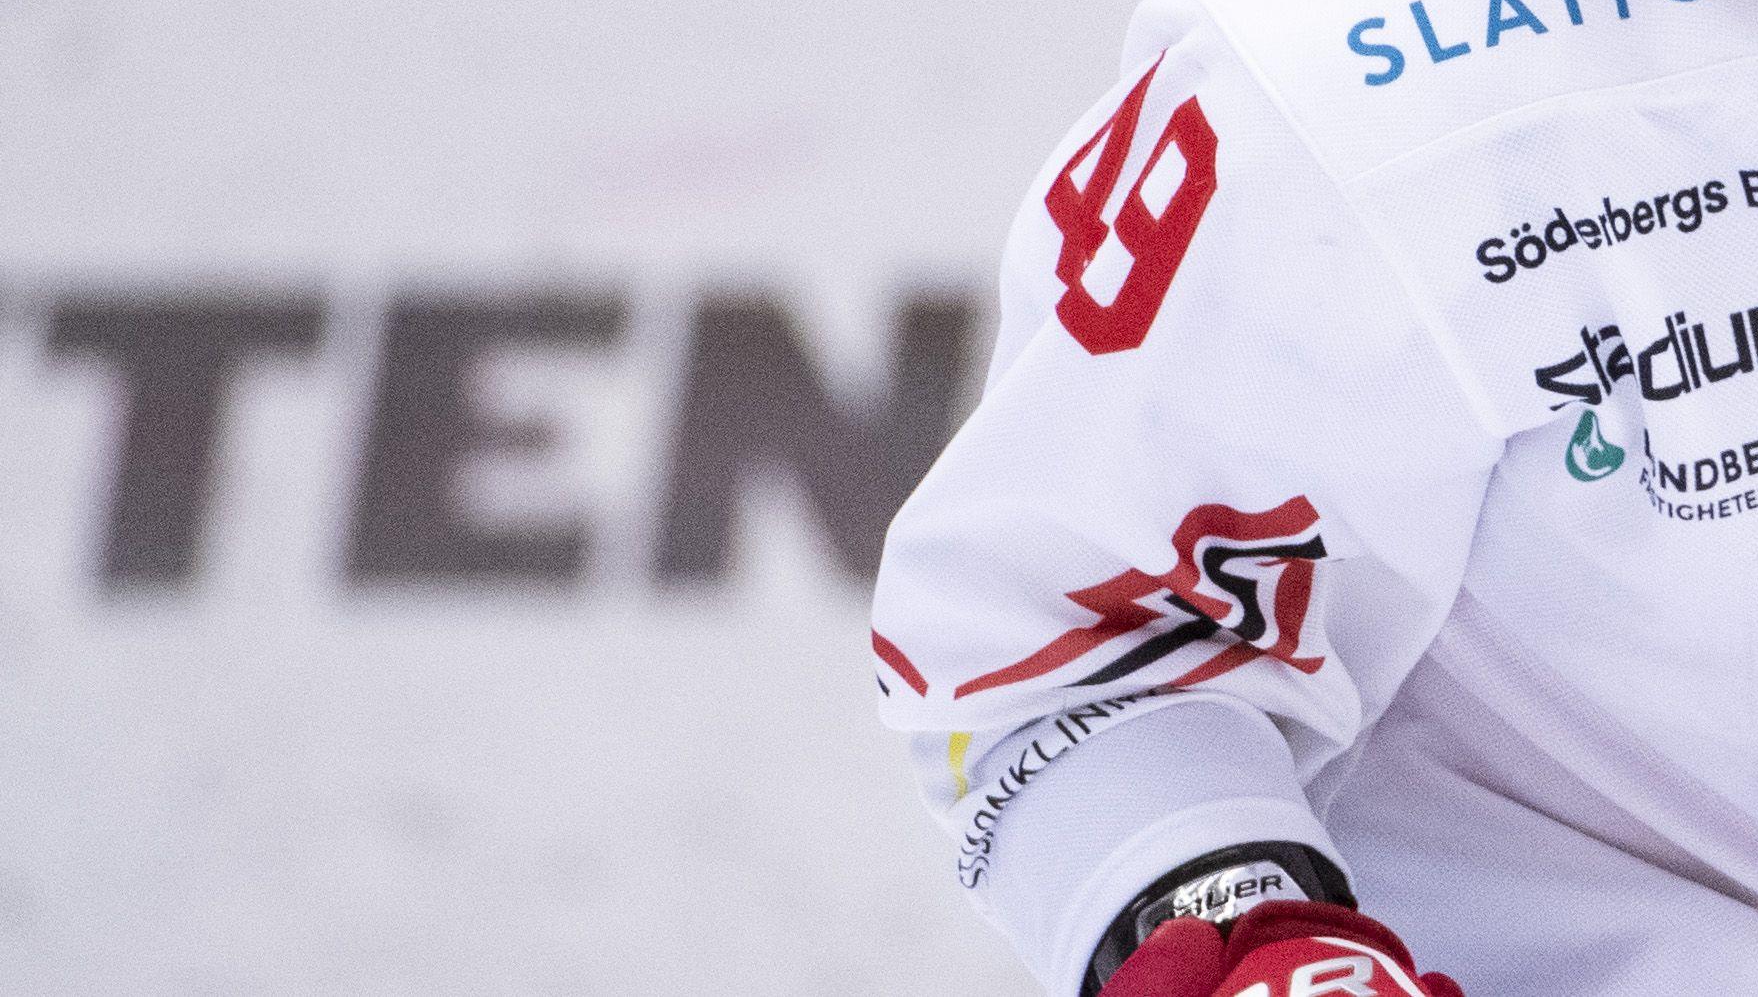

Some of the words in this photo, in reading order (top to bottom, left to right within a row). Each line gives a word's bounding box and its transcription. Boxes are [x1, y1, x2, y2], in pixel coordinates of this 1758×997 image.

[1044, 47, 1219, 356] 49
[1476, 180, 1729, 284] Söderbergs
[0, 282, 985, 597] TEN
